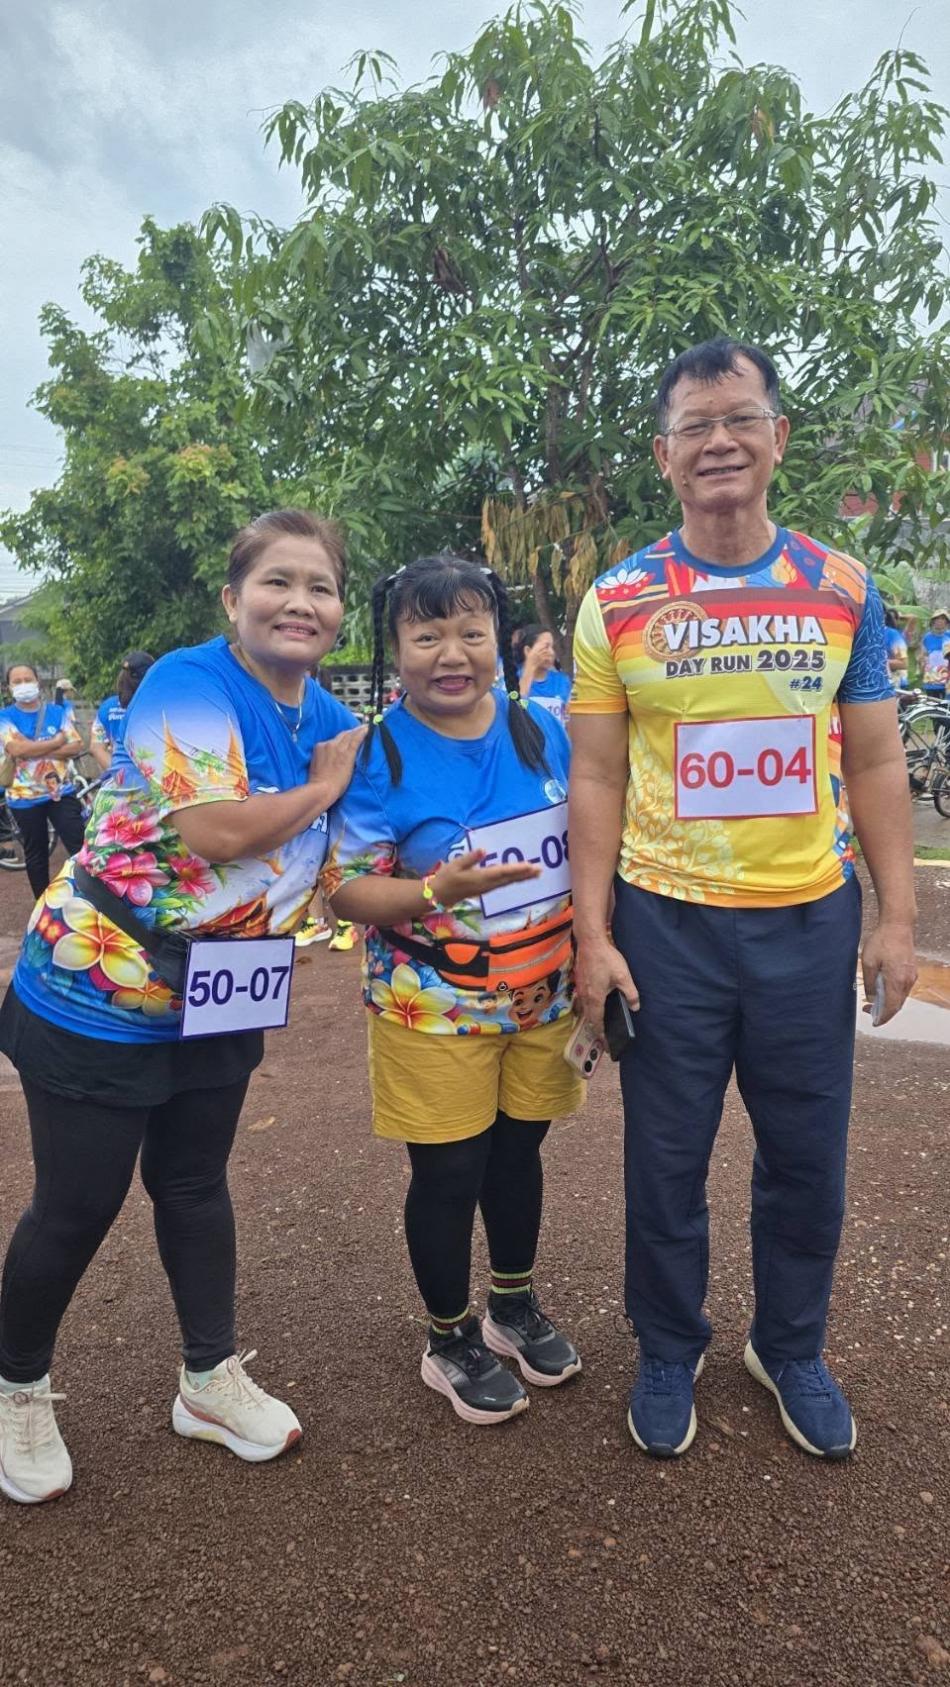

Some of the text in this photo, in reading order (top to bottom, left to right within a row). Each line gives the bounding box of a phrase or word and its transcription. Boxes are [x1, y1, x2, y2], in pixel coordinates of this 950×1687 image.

[663, 615, 827, 651] VISAKHA
[665, 650, 825, 678] DAY RUN 2025
[789, 676, 823, 691] #24
[680, 746, 812, 790] 60-04
[187, 965, 290, 1008] 50-07
